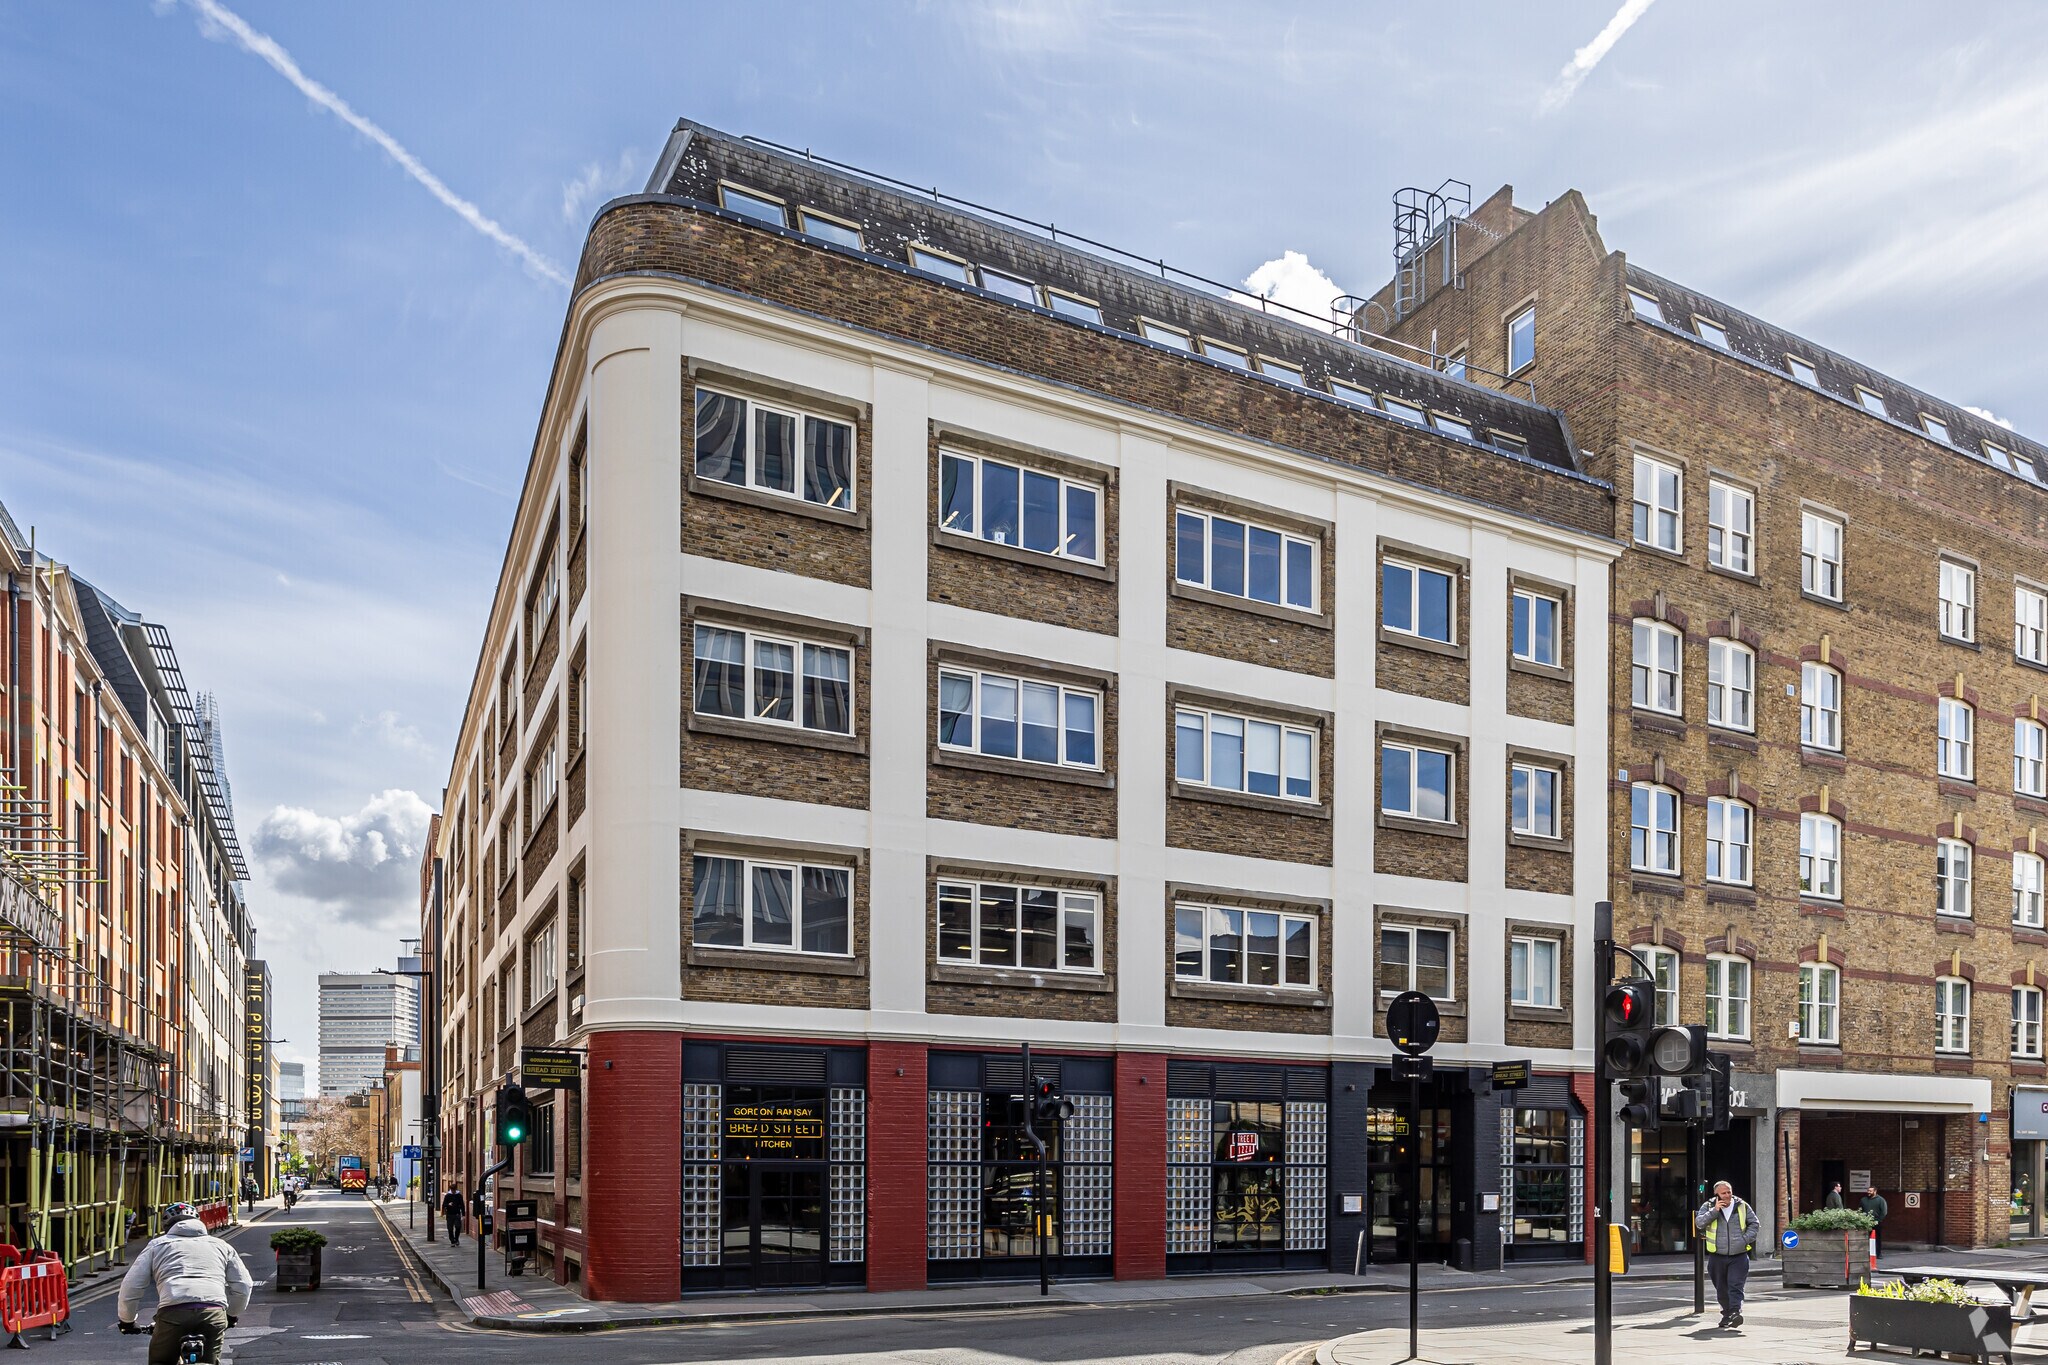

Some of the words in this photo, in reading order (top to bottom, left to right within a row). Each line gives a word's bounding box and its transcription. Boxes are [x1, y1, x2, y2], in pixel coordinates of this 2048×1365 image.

[247, 974, 262, 1002] THE
[247, 1013, 262, 1063] PRINT
[734, 1108, 773, 1116] GORDON
[729, 1123, 769, 1133] BREAD
[1236, 1134, 1254, 1142] TREET
[1236, 1145, 1252, 1154] IZZA
[1910, 1196, 1915, 1204] 5
